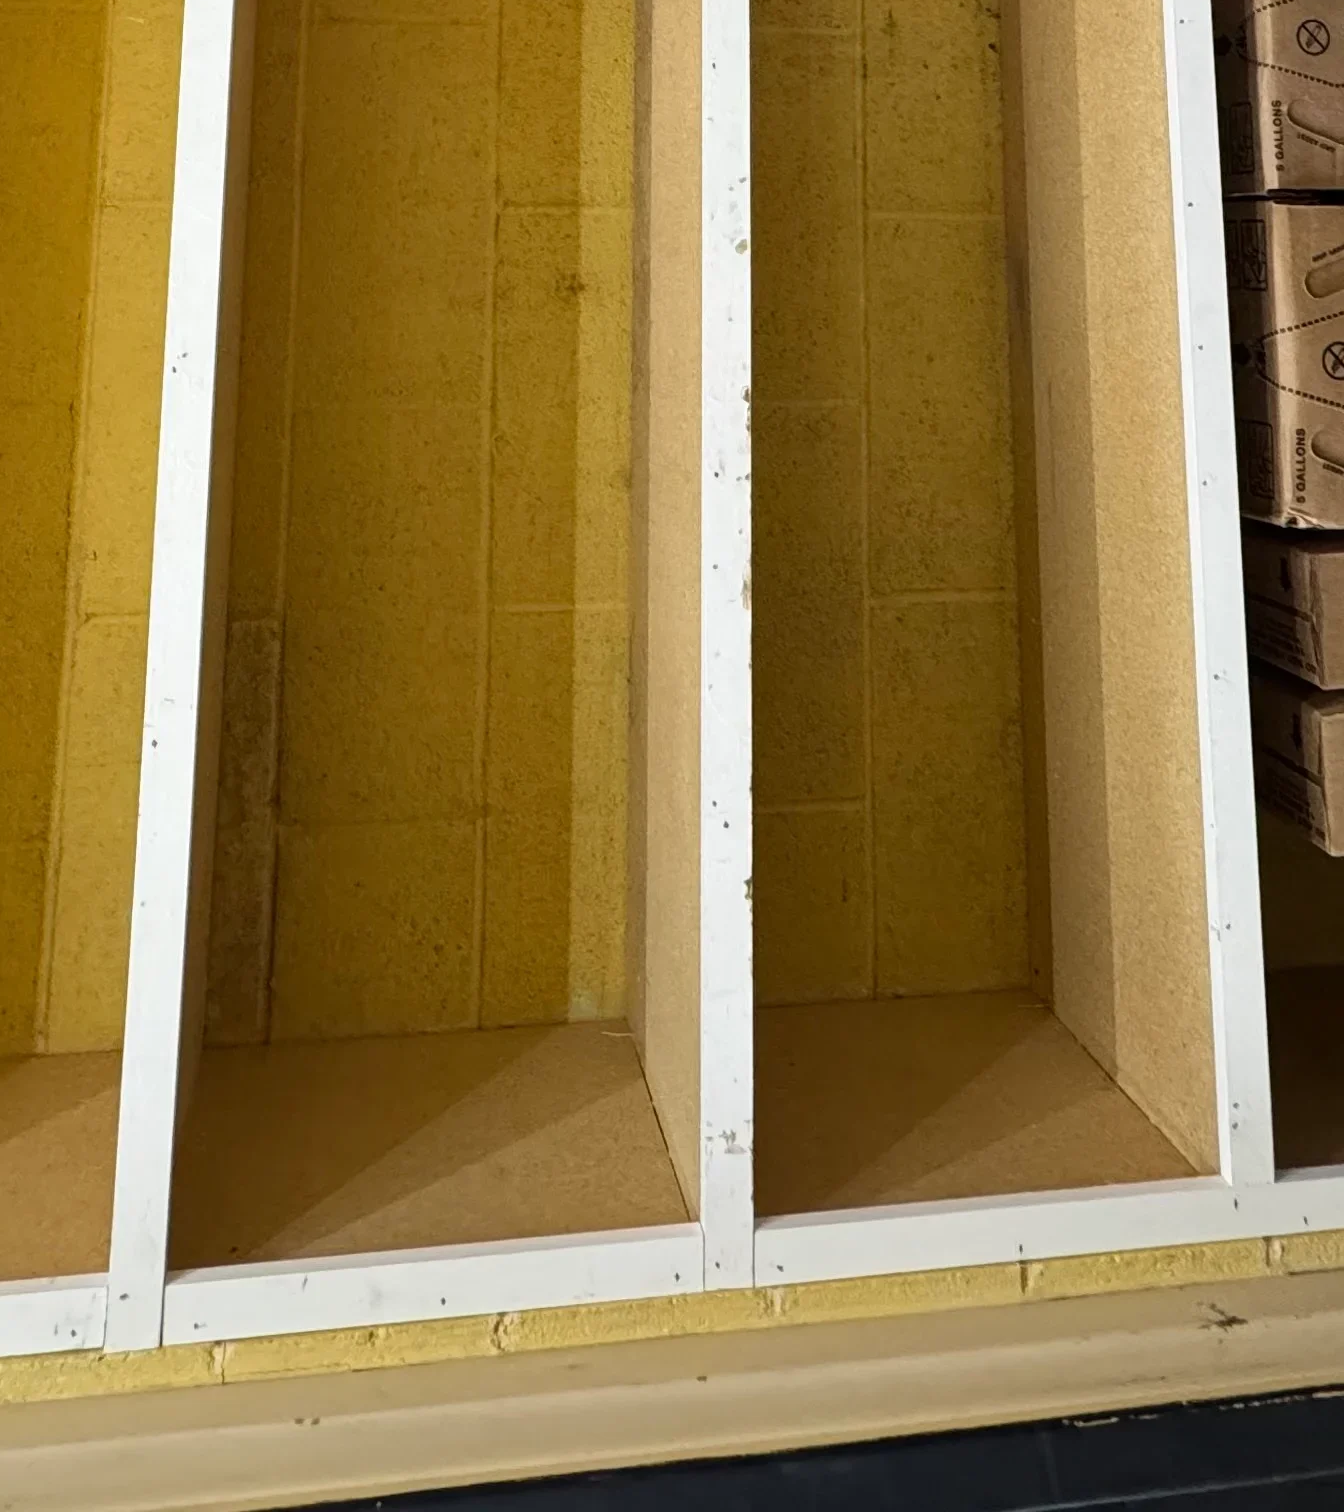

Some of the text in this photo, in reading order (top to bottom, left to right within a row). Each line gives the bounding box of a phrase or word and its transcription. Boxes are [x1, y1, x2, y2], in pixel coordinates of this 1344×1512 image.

[1271, 100, 1286, 172] 5 GALLONS
[1294, 428, 1306, 504] 5 GALLONS
